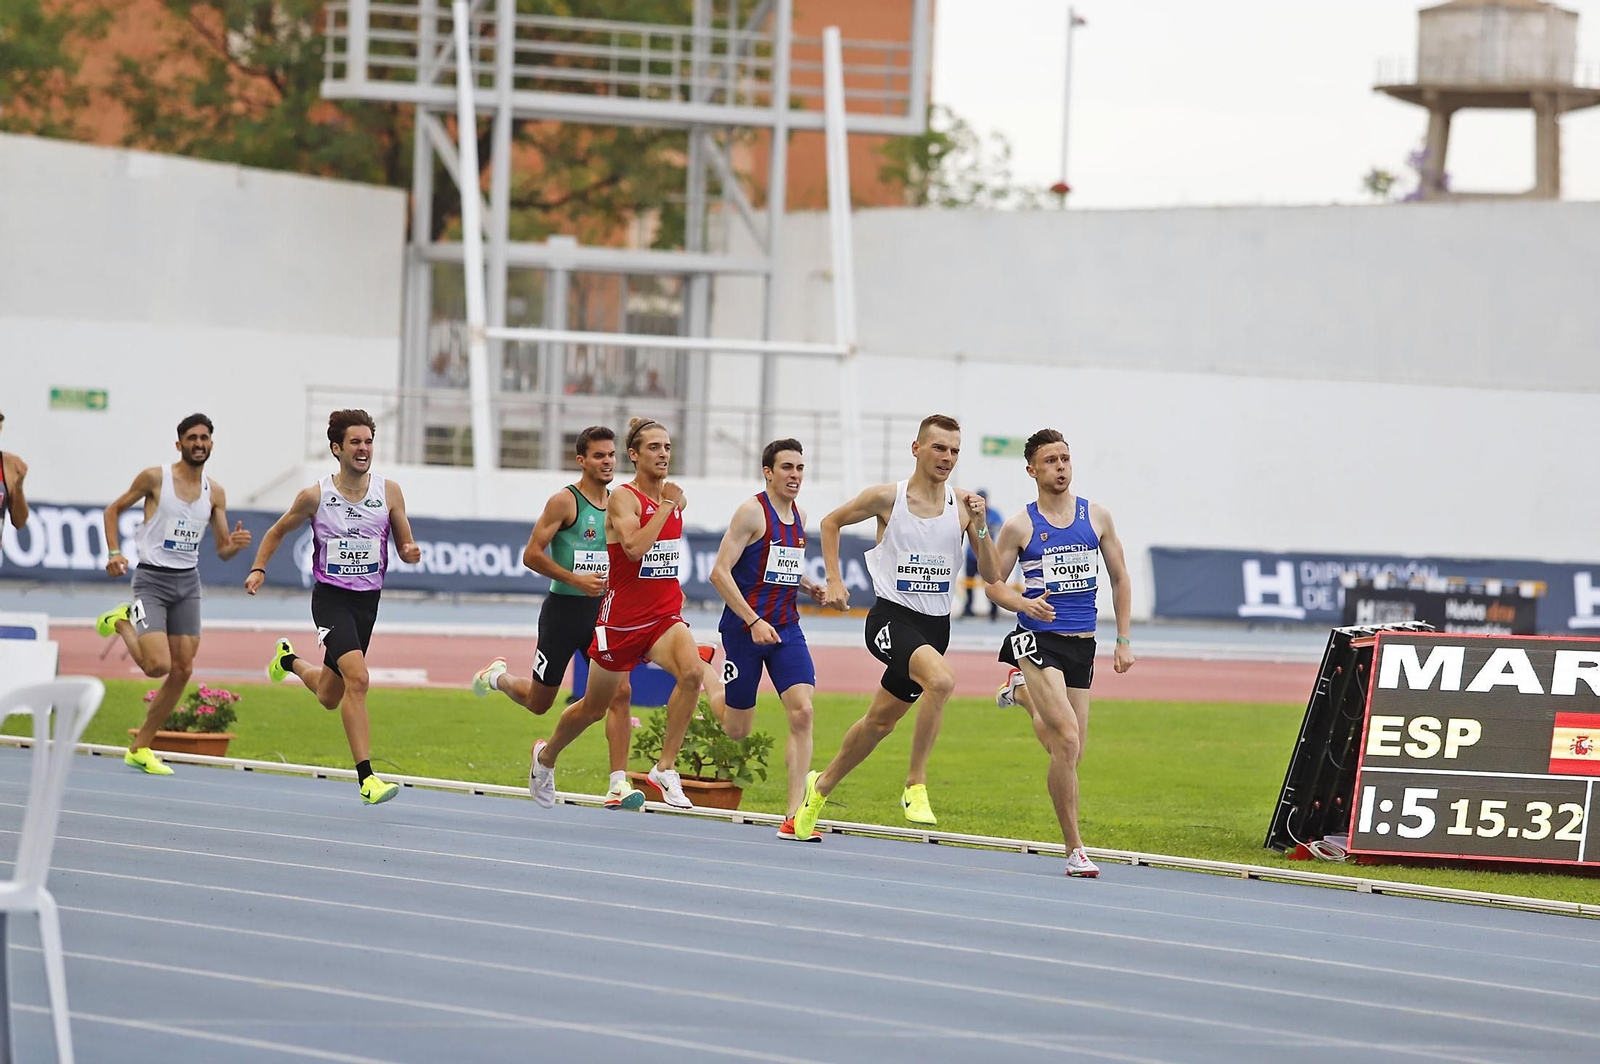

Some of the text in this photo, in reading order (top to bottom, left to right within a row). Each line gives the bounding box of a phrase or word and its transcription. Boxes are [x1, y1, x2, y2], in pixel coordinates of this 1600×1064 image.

[0, 506, 140, 572] oma
[340, 551, 369, 560] SAEZ
[1043, 544, 1088, 555] MORPETH
[574, 562, 609, 572] PANIAG
[777, 558, 799, 569] MOYA
[1050, 563, 1090, 576] YOUNG
[338, 565, 369, 575] Joma
[897, 565, 951, 576] BERTASIUS
[775, 573, 798, 583] Joma
[908, 581, 940, 592] Joma
[1057, 580, 1089, 592] Joma
[1013, 633, 1036, 656] 12
[537, 653, 545, 671] 7
[723, 663, 734, 682] 8
[1378, 643, 1600, 697] MAR
[1366, 714, 1483, 760] ESP
[1446, 798, 1585, 843] 15.32
